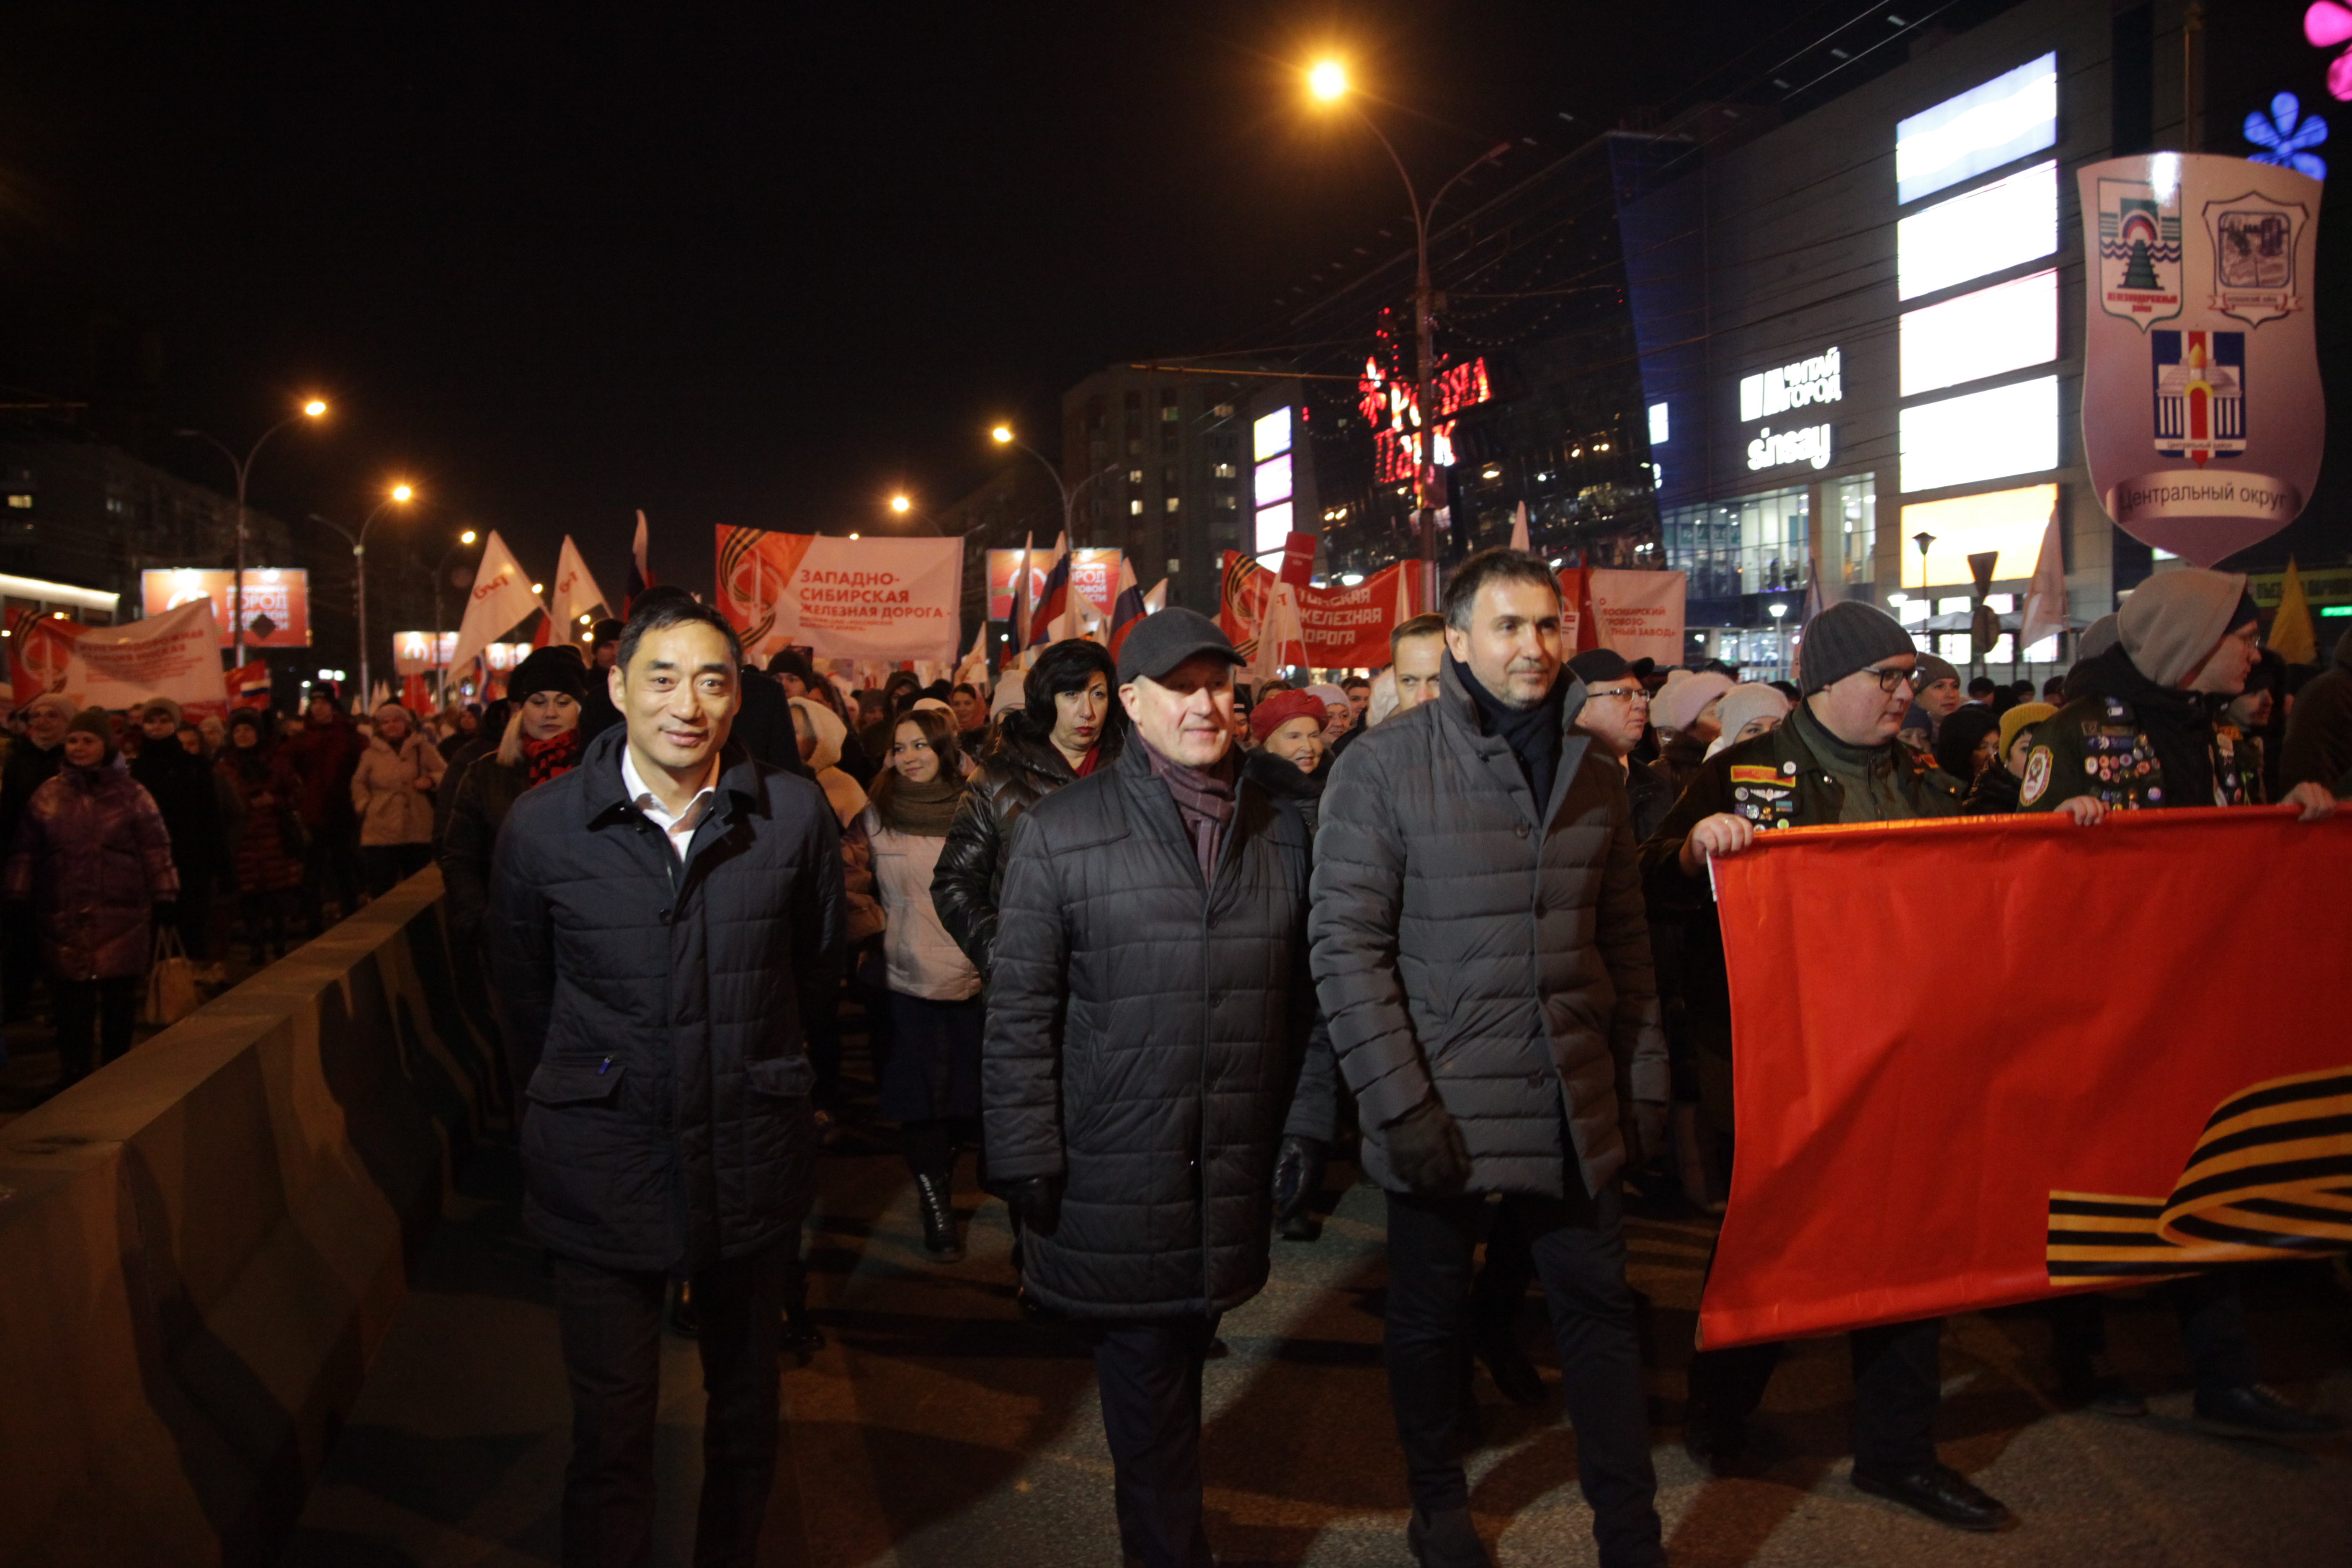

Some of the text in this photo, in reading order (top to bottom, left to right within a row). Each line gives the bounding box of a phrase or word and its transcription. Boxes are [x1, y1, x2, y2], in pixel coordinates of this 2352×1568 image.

[1784, 346, 1840, 387] ЧИТАЙ
[1780, 374, 1842, 412] ГОРОД
[1747, 424, 1830, 470] sinsay
[2120, 482, 2287, 510] Центральный округ
[800, 569, 900, 587] ЗАПАДНО-
[1071, 570, 1106, 583] РОД
[800, 588, 910, 603] СИБИРСКАЯ
[799, 603, 878, 617] ЖЕЛЕЗНАЯ
[881, 606, 943, 620] ДОРОГА
[1299, 608, 1382, 626] ЖЕЛЕЗНАЯ
